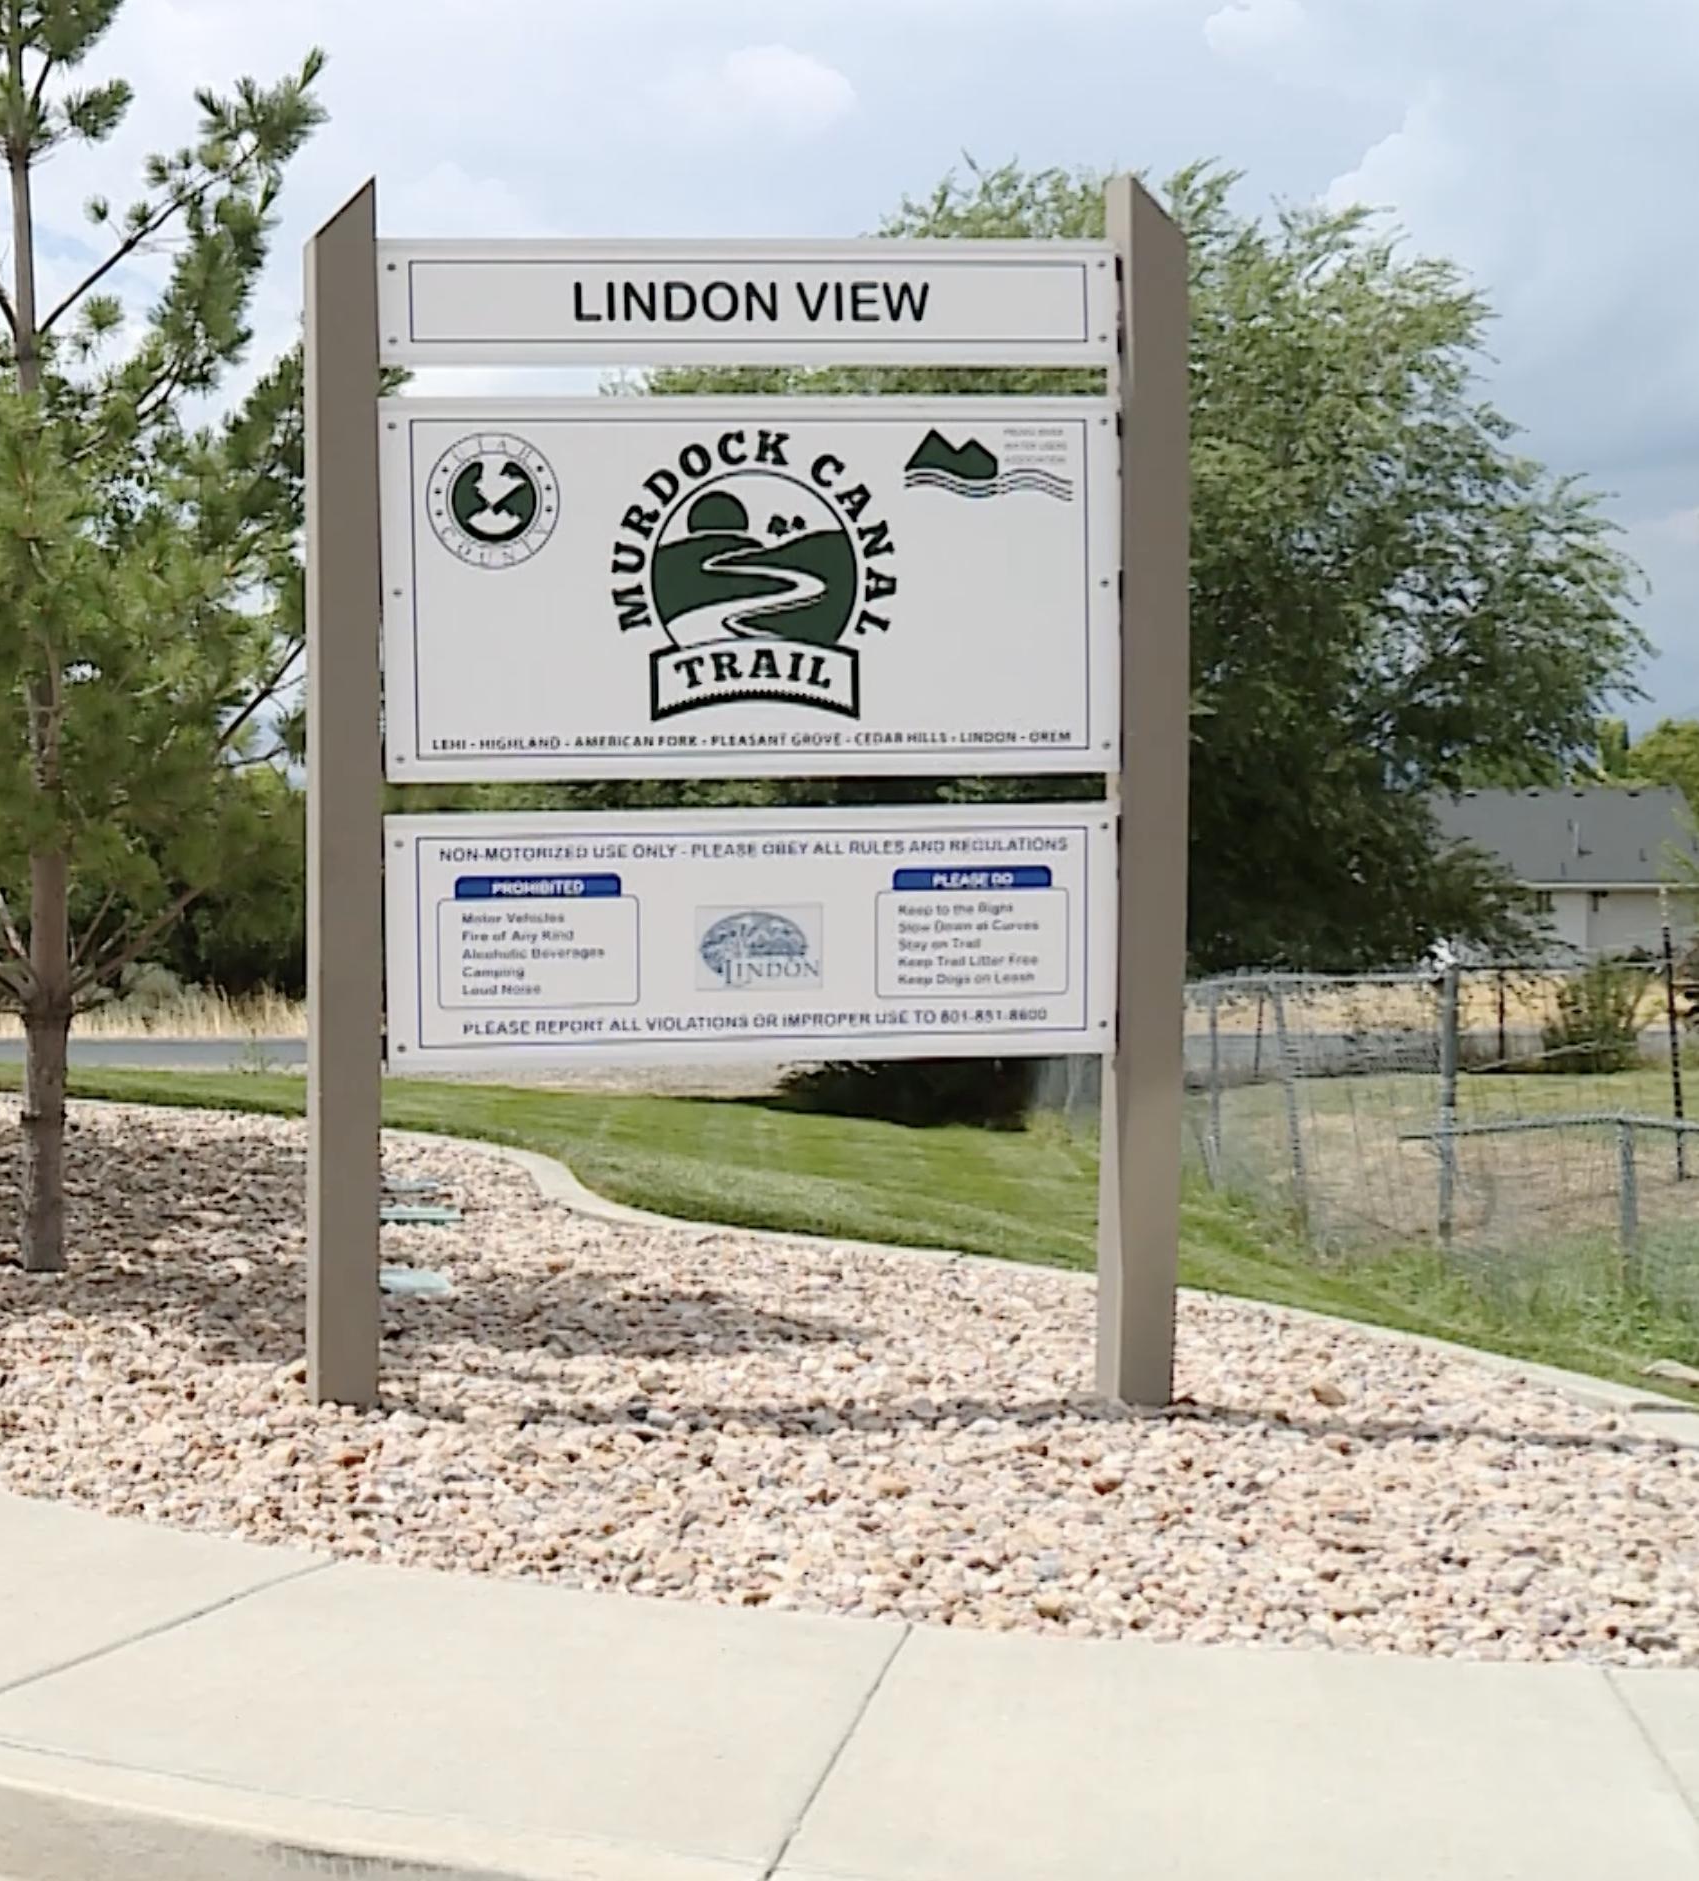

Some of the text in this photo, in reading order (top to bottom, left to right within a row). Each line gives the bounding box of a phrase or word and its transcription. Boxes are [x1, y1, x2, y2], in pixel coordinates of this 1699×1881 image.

[573, 280, 931, 323] LINDON VIEW
[611, 429, 898, 636] MURDOCK CANAL
[673, 648, 831, 689] TRAIL
[432, 739, 466, 750] LEHI
[479, 738, 561, 750] HIGHLAND
[574, 735, 654, 747] AMERICAN
[658, 735, 697, 747] FORK
[710, 733, 786, 746] PLEASANT
[791, 732, 842, 746] GROVE
[854, 732, 903, 745] CEDAR
[906, 731, 948, 744] HILLS
[959, 731, 1017, 743] LINDON
[1029, 731, 1071, 742] OREM
[439, 846, 588, 862] NON-MOTORIZED
[592, 844, 627, 859] USE
[632, 843, 676, 858] ONLY
[691, 842, 758, 858] PLEASE
[761, 840, 808, 856] OBEY
[813, 840, 844, 855] ALL
[849, 838, 904, 855] RULES
[908, 839, 946, 854] AND
[949, 836, 1068, 852] REGULATIONS
[491, 879, 585, 895] PROHIBITED
[932, 871, 1014, 888] PLEASE DO
[898, 902, 1013, 917] Keep to the Right
[461, 912, 565, 924] Motor Vehicles
[898, 920, 1039, 934] Slow Down at Curves
[461, 929, 574, 944] Fire of Any Kind
[898, 938, 981, 952] Stay on Trail
[461, 947, 605, 960] Alcoholic Beverages
[898, 952, 1038, 969] Keep Trail Litter Free
[461, 966, 525, 980] Camping
[724, 959, 820, 987] LINDON
[898, 972, 1035, 988] Keep Dogs on Leash
[461, 983, 541, 996] Loud Noise
[463, 1008, 1048, 1036] PLEASE REPORT ALL VIOLATIONS OR IMPROPER USE TO 801-851-8600
